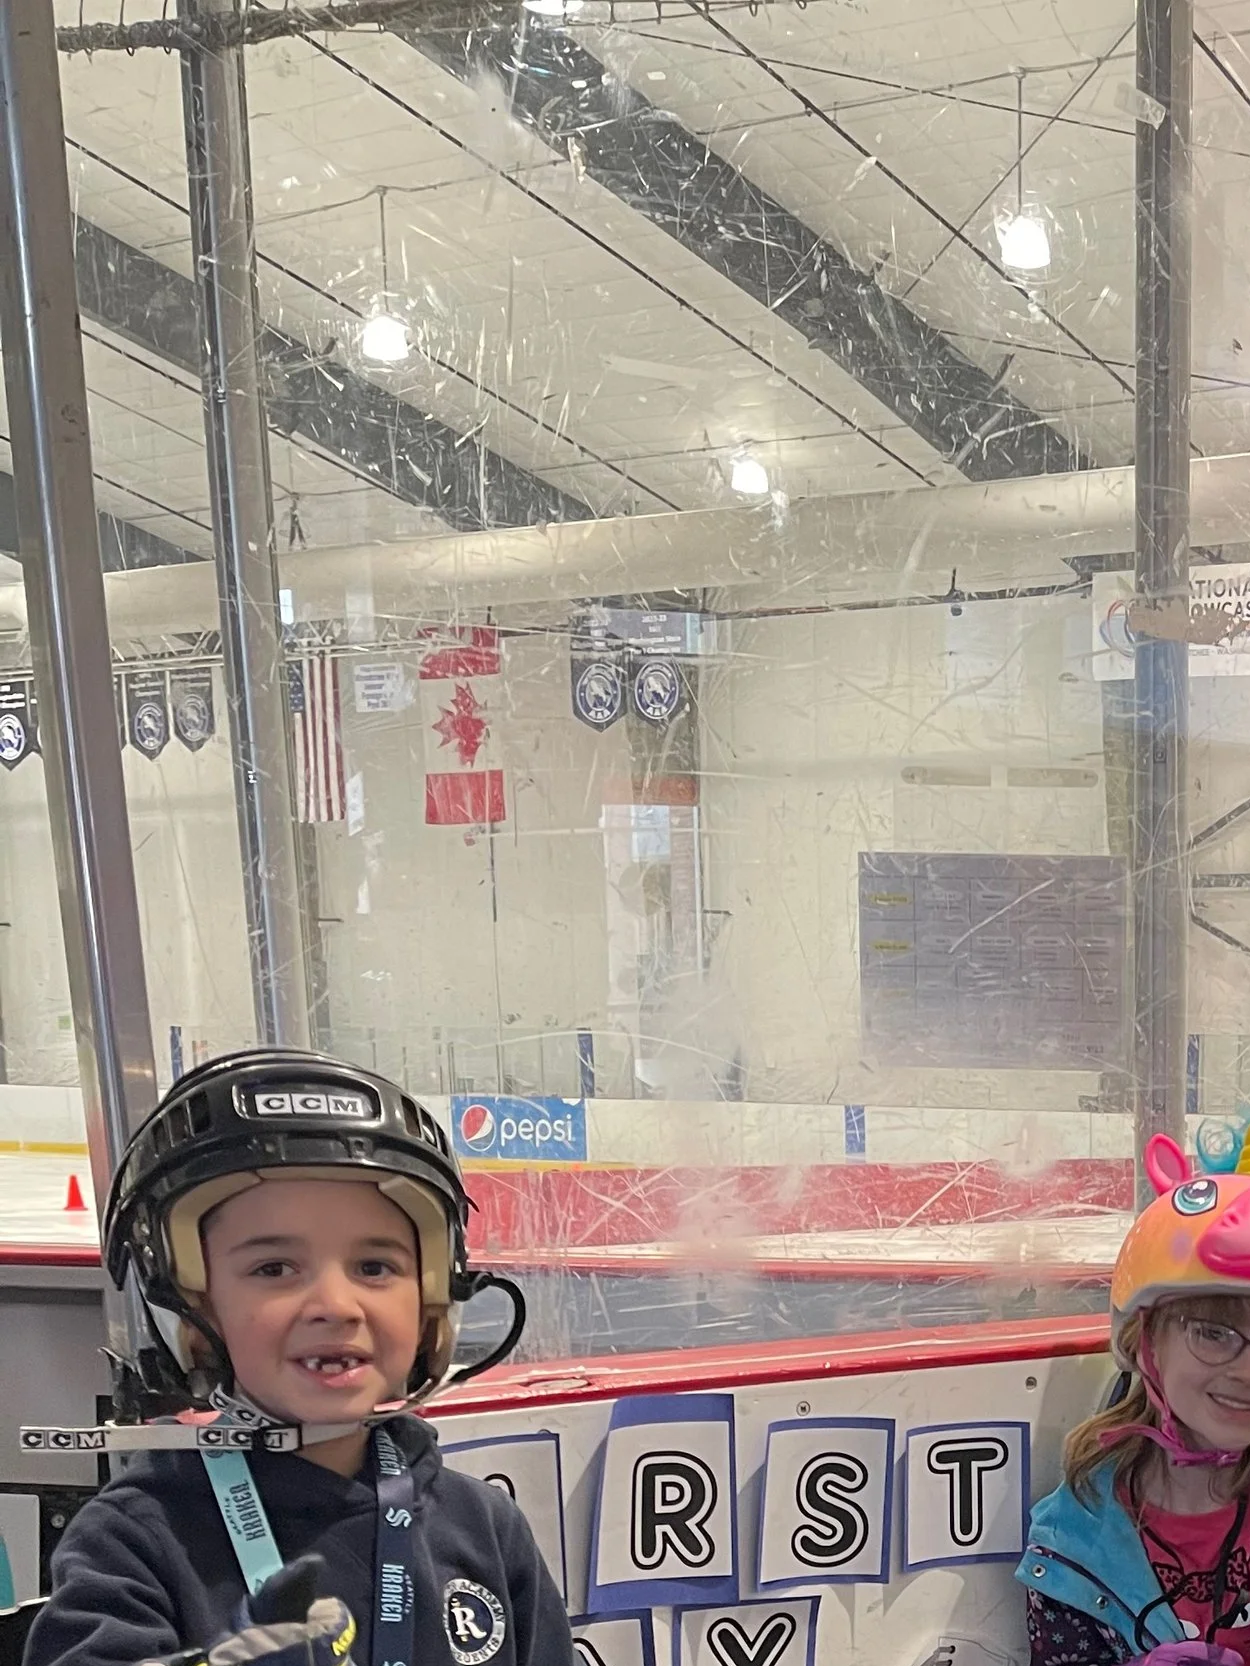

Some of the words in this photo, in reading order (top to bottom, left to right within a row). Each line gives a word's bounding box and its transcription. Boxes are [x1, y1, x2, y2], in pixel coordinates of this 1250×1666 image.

[261, 1096, 360, 1113] CCM
[501, 1115, 573, 1148] pepsi
[22, 1431, 104, 1448] CCM
[484, 1436, 1009, 1571] RST
[451, 1605, 488, 1641] R
